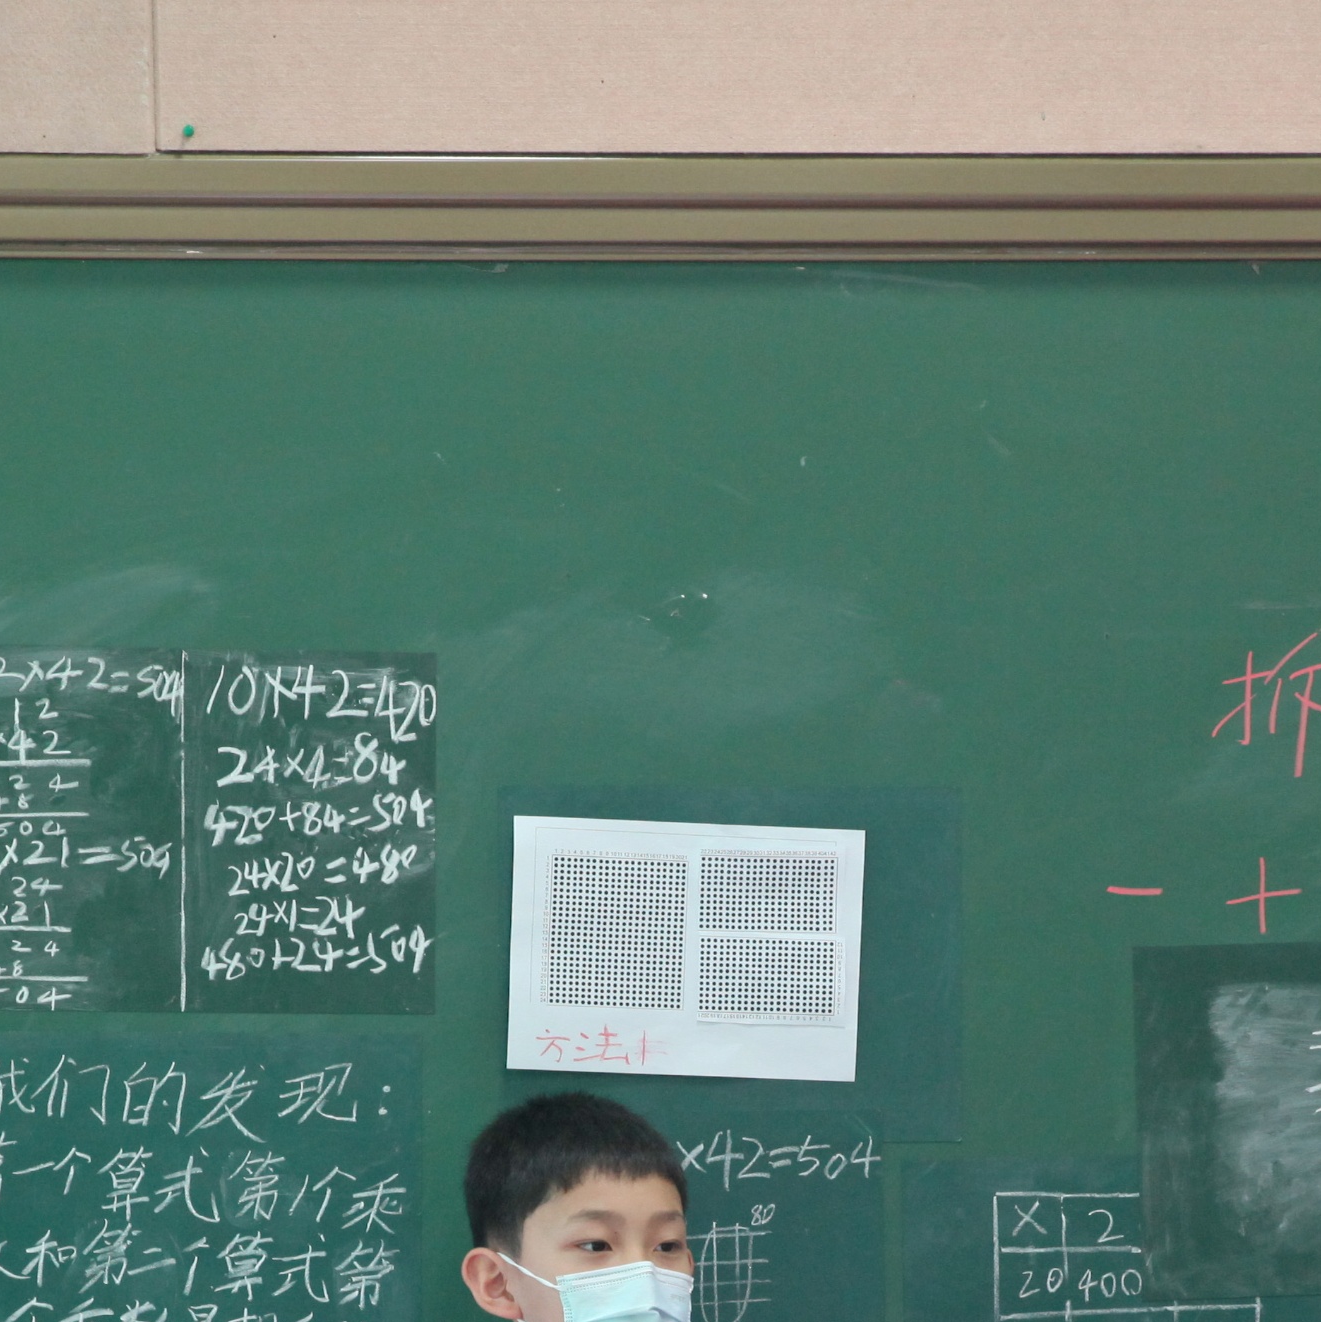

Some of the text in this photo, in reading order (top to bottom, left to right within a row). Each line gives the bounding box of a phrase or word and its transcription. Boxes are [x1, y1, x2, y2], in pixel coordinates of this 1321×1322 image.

[12, 876, 64, 897] 24
[751, 1203, 776, 1226] 80
[1088, 1209, 1124, 1242] 2
[1018, 1268, 1142, 1301] 20 400
